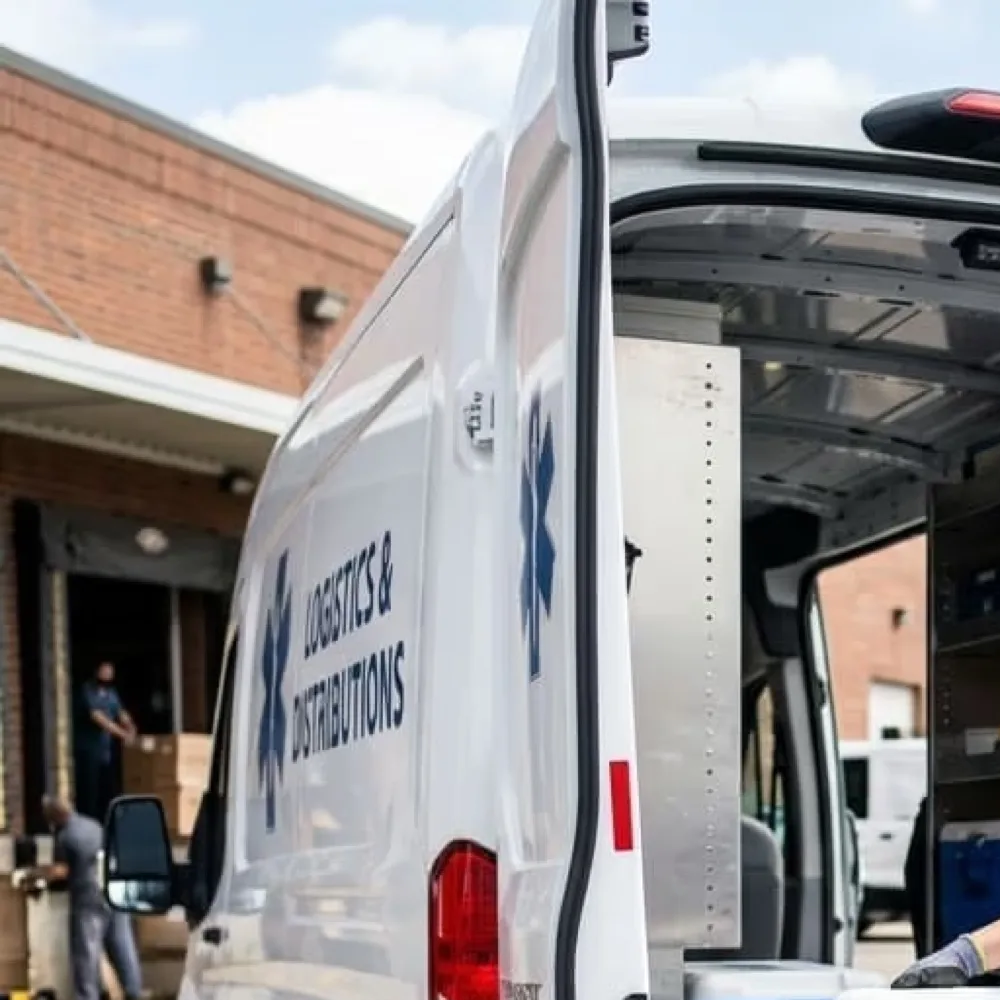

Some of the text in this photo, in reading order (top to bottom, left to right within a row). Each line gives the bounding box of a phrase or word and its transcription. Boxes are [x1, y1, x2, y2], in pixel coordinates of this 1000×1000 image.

[304, 530, 393, 660] LOGISTICS &
[292, 640, 404, 762] DISTRIBUTIONS
